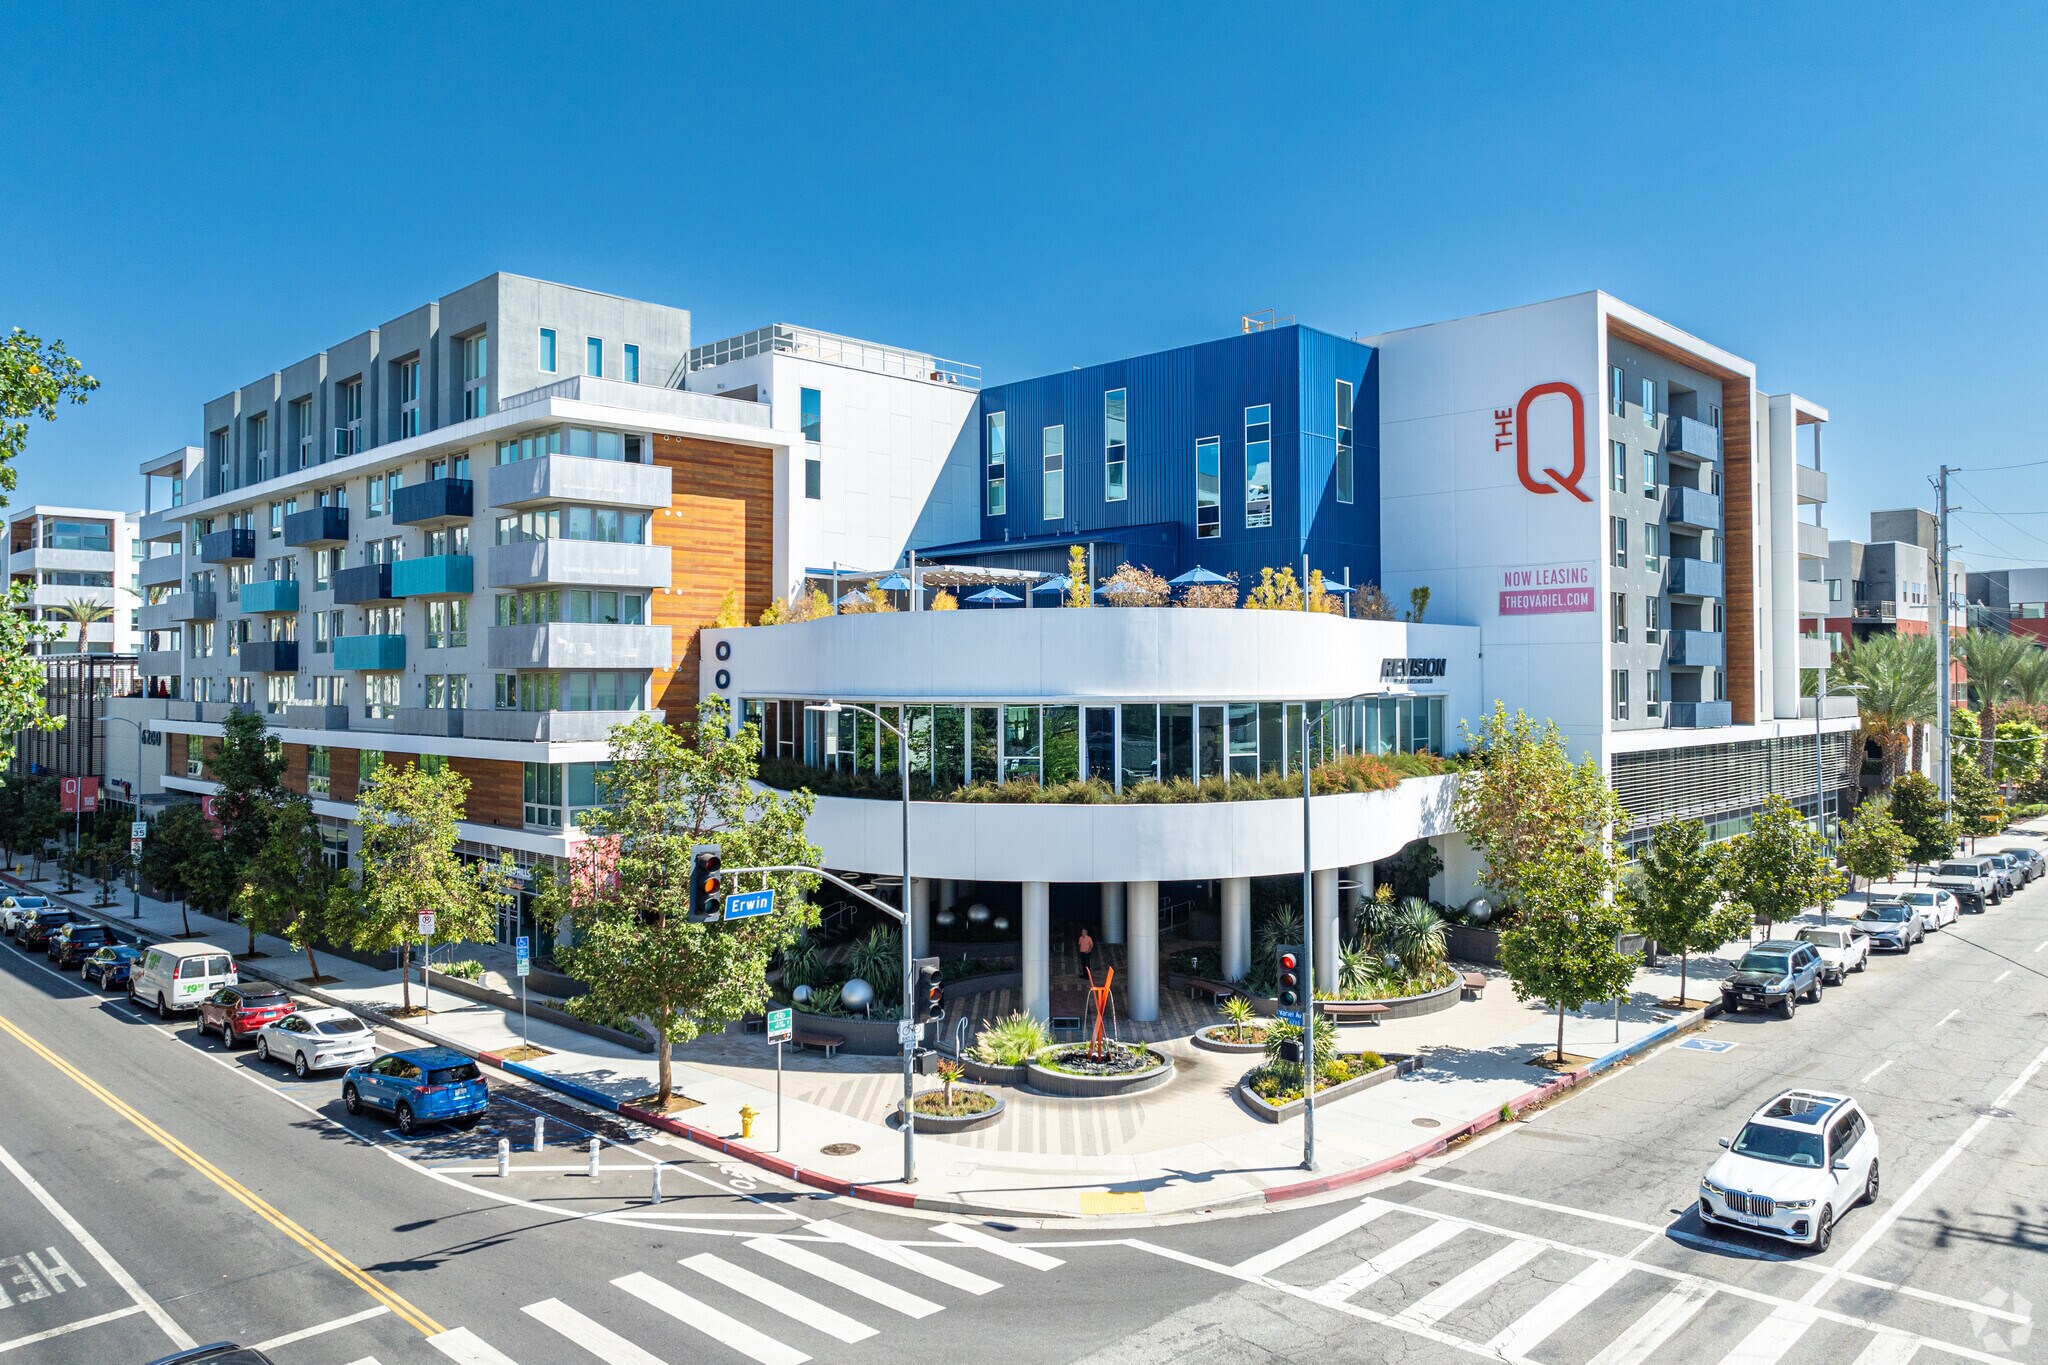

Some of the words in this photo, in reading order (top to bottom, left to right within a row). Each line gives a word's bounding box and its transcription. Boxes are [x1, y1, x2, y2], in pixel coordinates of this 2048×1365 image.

[1494, 407, 1513, 452] THE
[1516, 381, 1594, 503] Q
[1504, 571, 1532, 587] NOW
[1536, 567, 1588, 586] LEASING
[1505, 592, 1589, 609] THEQVARIEL.COM
[1381, 658, 1447, 676] REVISION
[141, 729, 162, 747] 6200
[731, 896, 768, 912] Erwin
